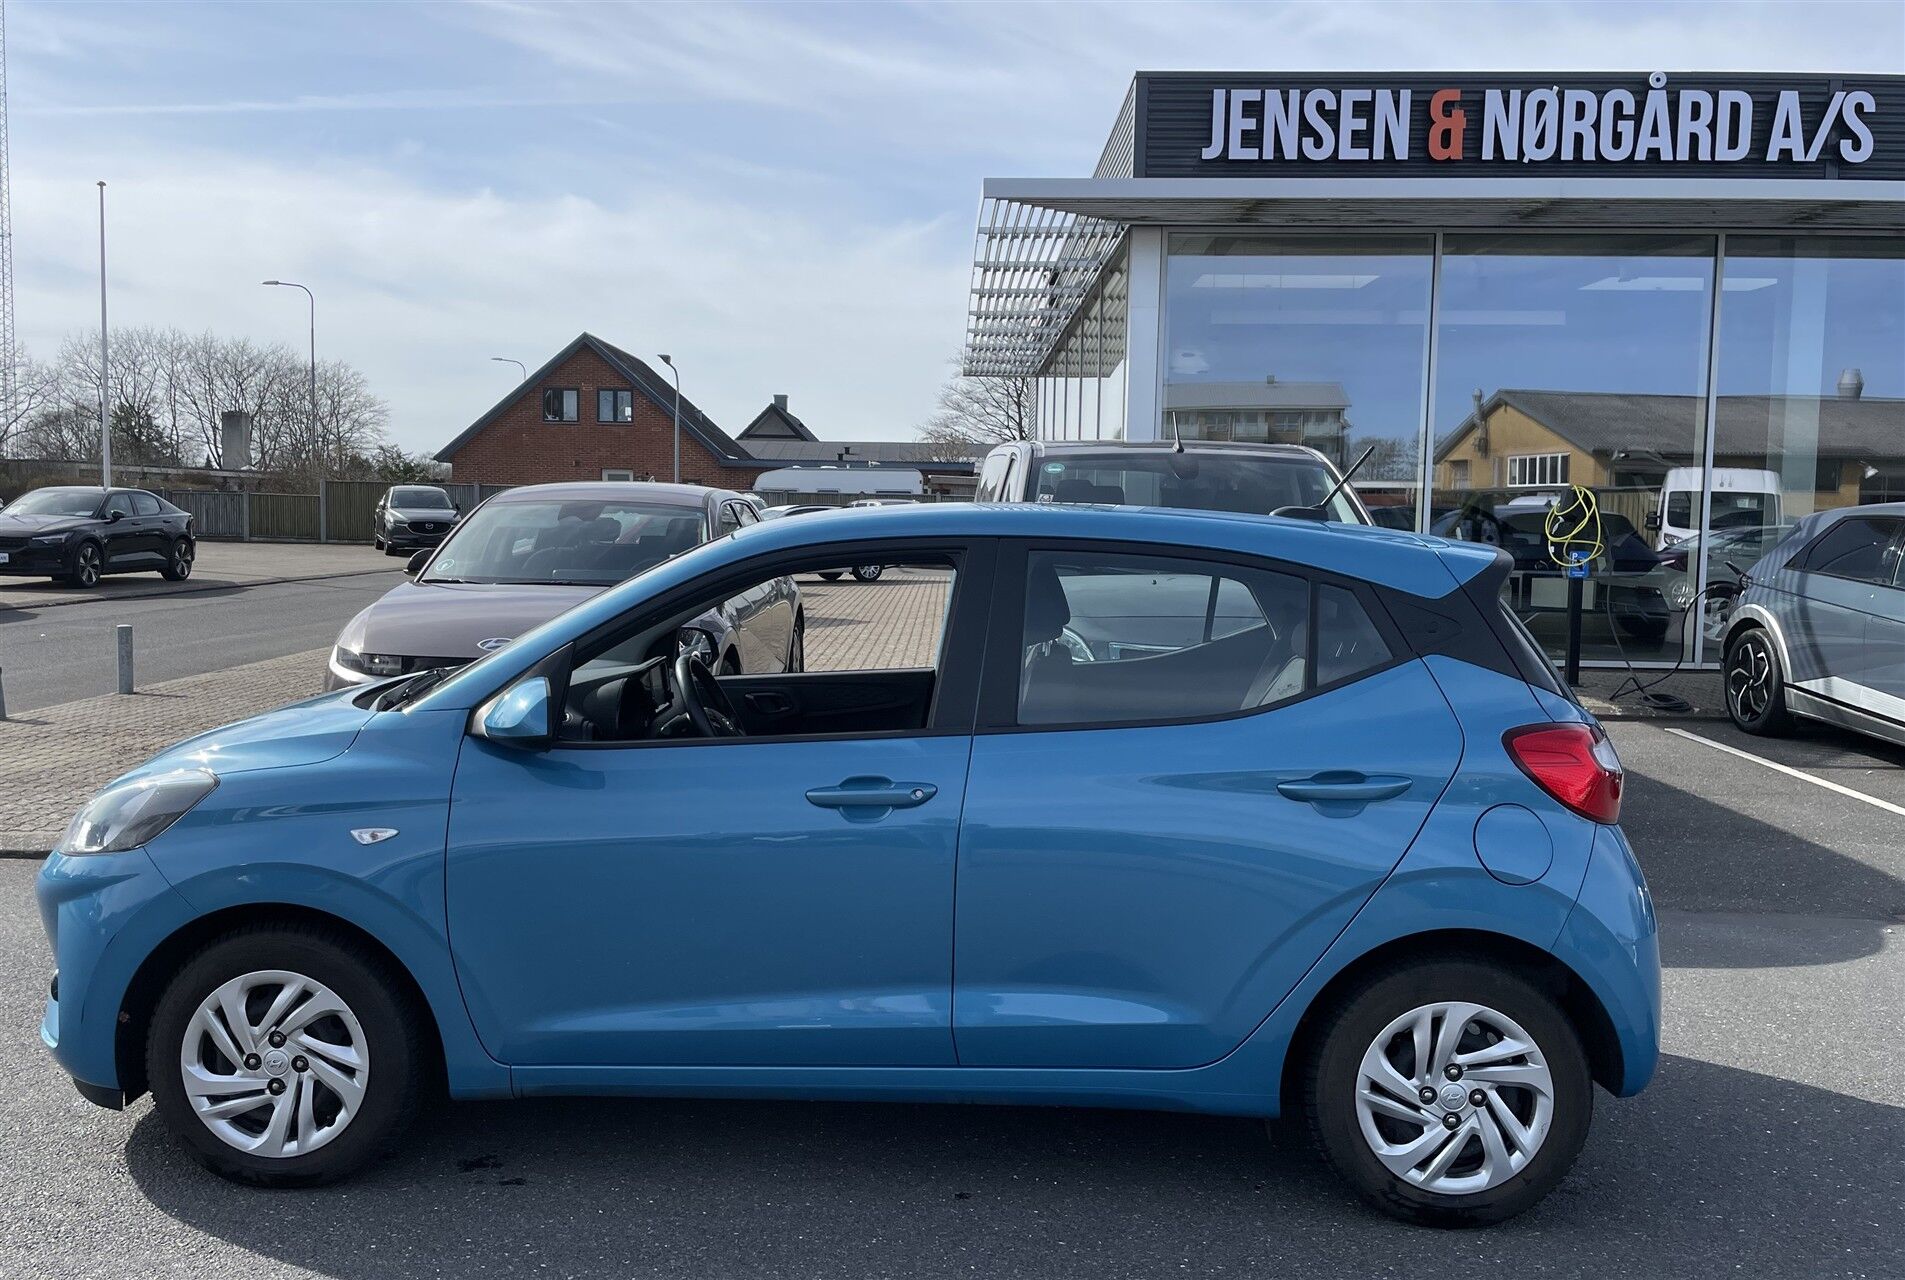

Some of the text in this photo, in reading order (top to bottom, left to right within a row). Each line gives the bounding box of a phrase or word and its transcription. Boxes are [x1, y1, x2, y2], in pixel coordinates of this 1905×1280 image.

[1201, 71, 1876, 163] JENSEN & NØRGÅRD A/S
